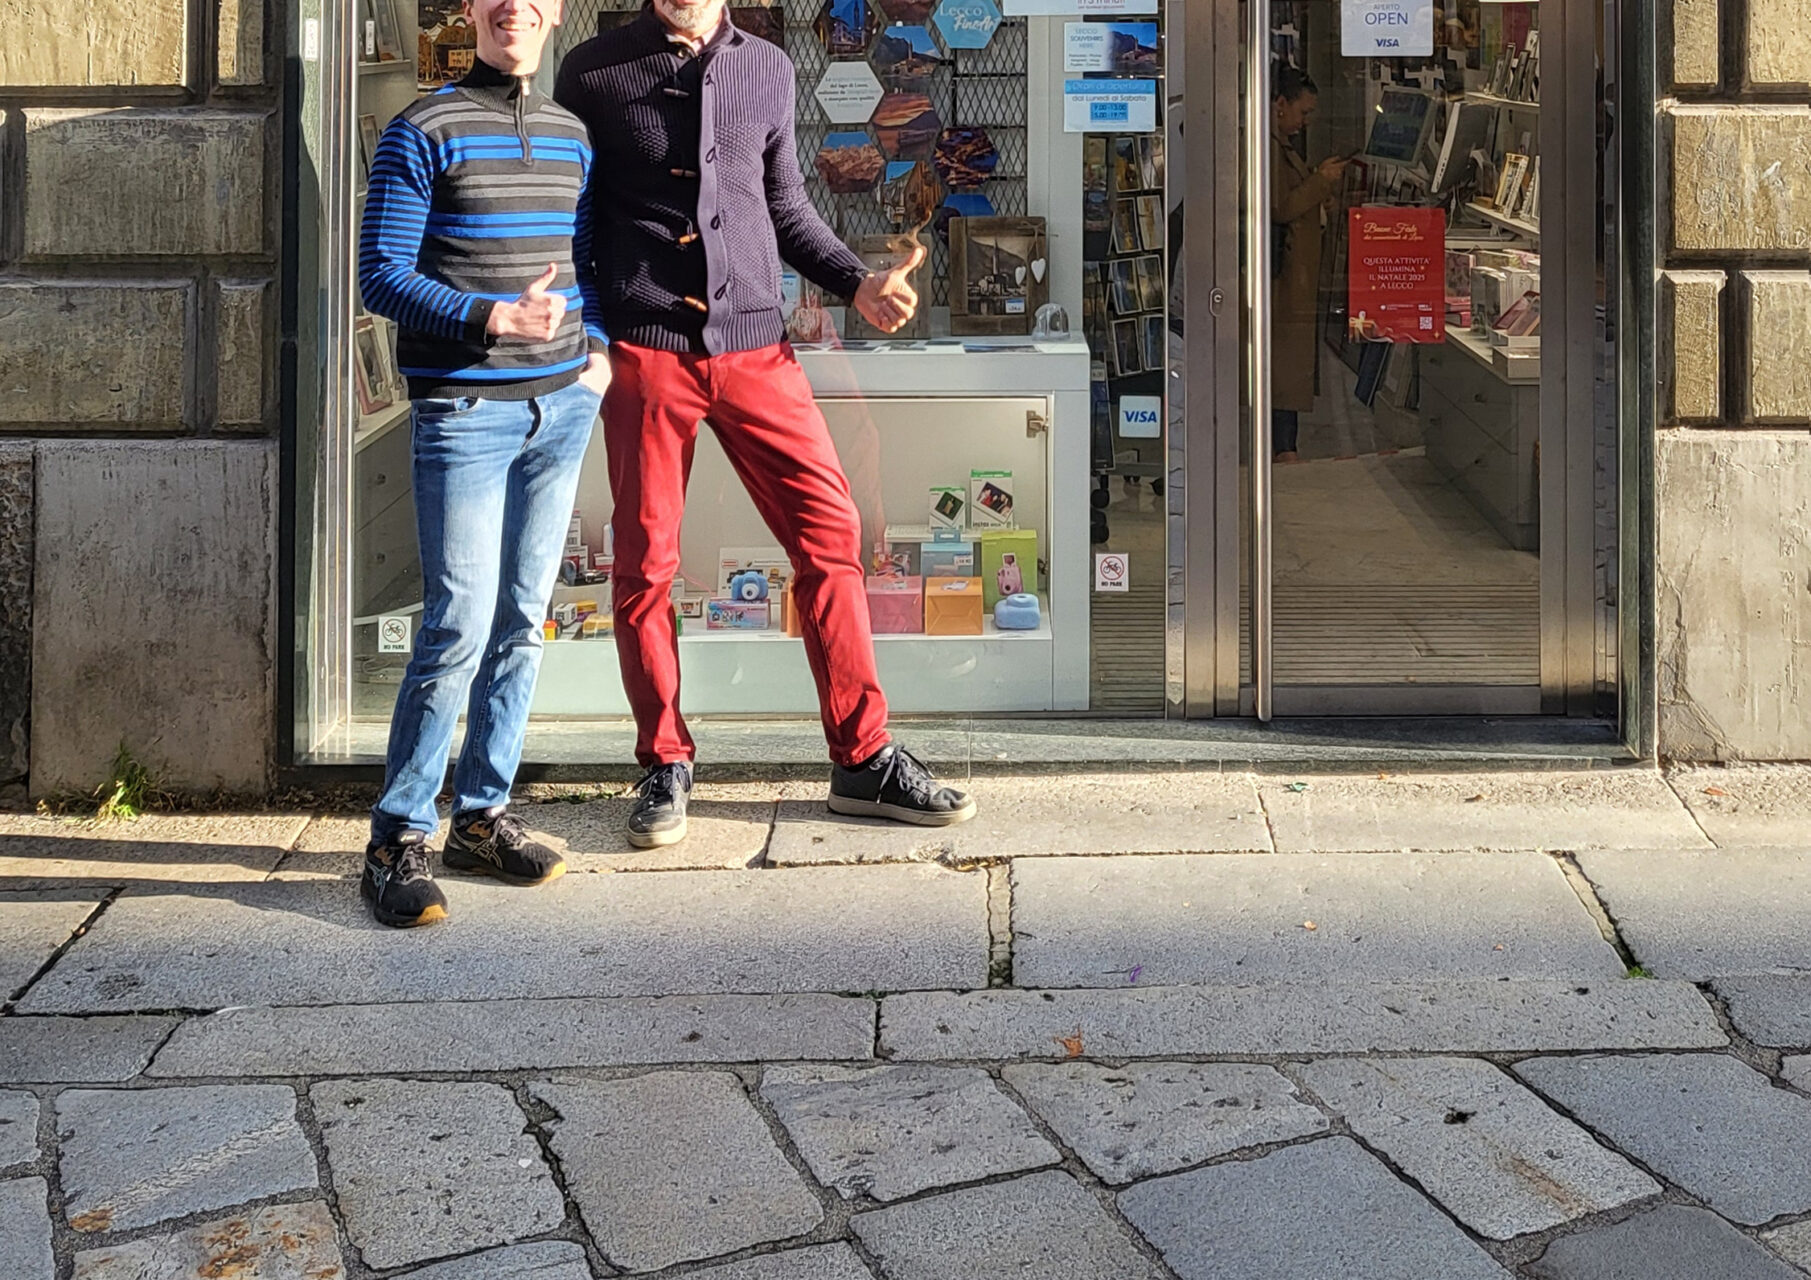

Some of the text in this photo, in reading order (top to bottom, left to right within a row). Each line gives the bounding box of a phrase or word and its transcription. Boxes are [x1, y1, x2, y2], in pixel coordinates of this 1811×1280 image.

[940, 2, 982, 16] Lecco
[1365, 12, 1408, 25] OPEN
[1375, 38, 1400, 48] VISA
[1363, 257, 1393, 266] QUESTA
[1123, 410, 1157, 423] VISA
